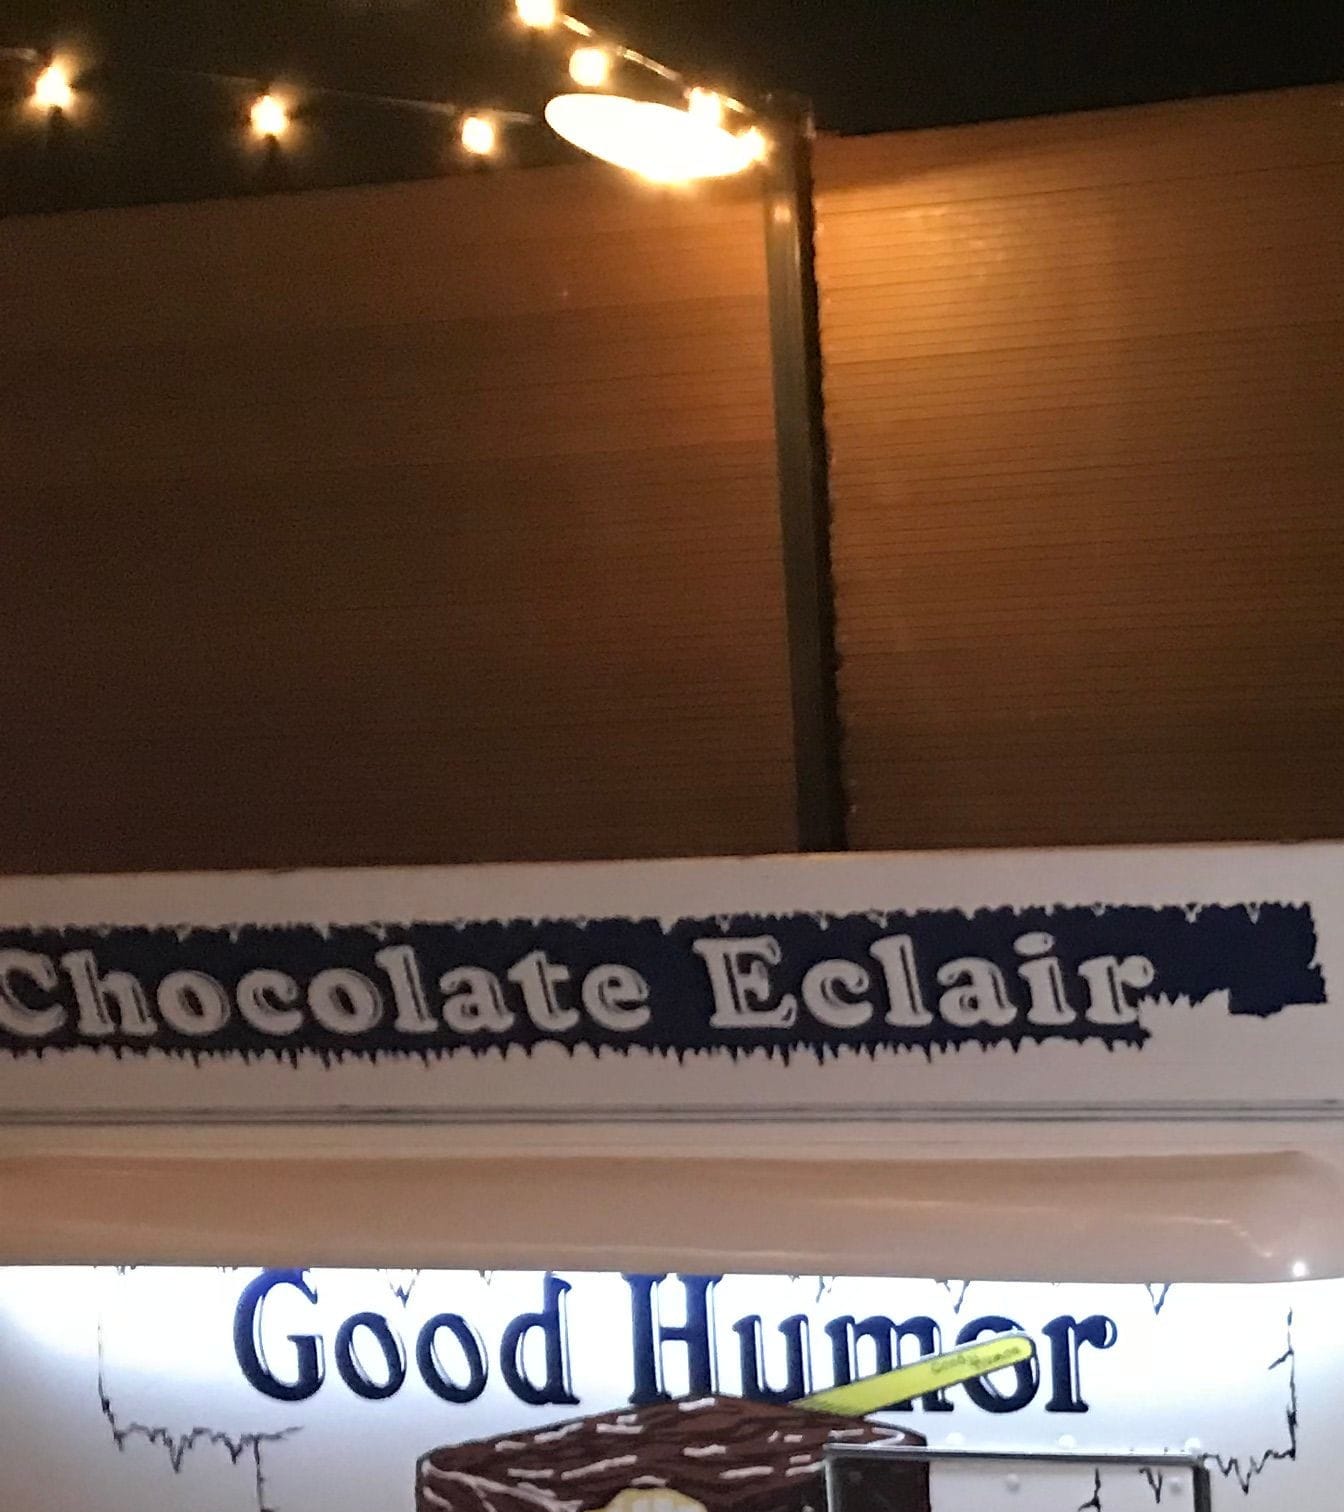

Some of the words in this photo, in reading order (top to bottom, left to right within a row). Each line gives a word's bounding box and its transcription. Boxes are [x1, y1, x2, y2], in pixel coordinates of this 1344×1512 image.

[0, 944, 652, 1036] Chocolate
[692, 930, 1156, 1029] Eclair
[233, 1268, 581, 1405] Good
[621, 1273, 1118, 1413] Humor
